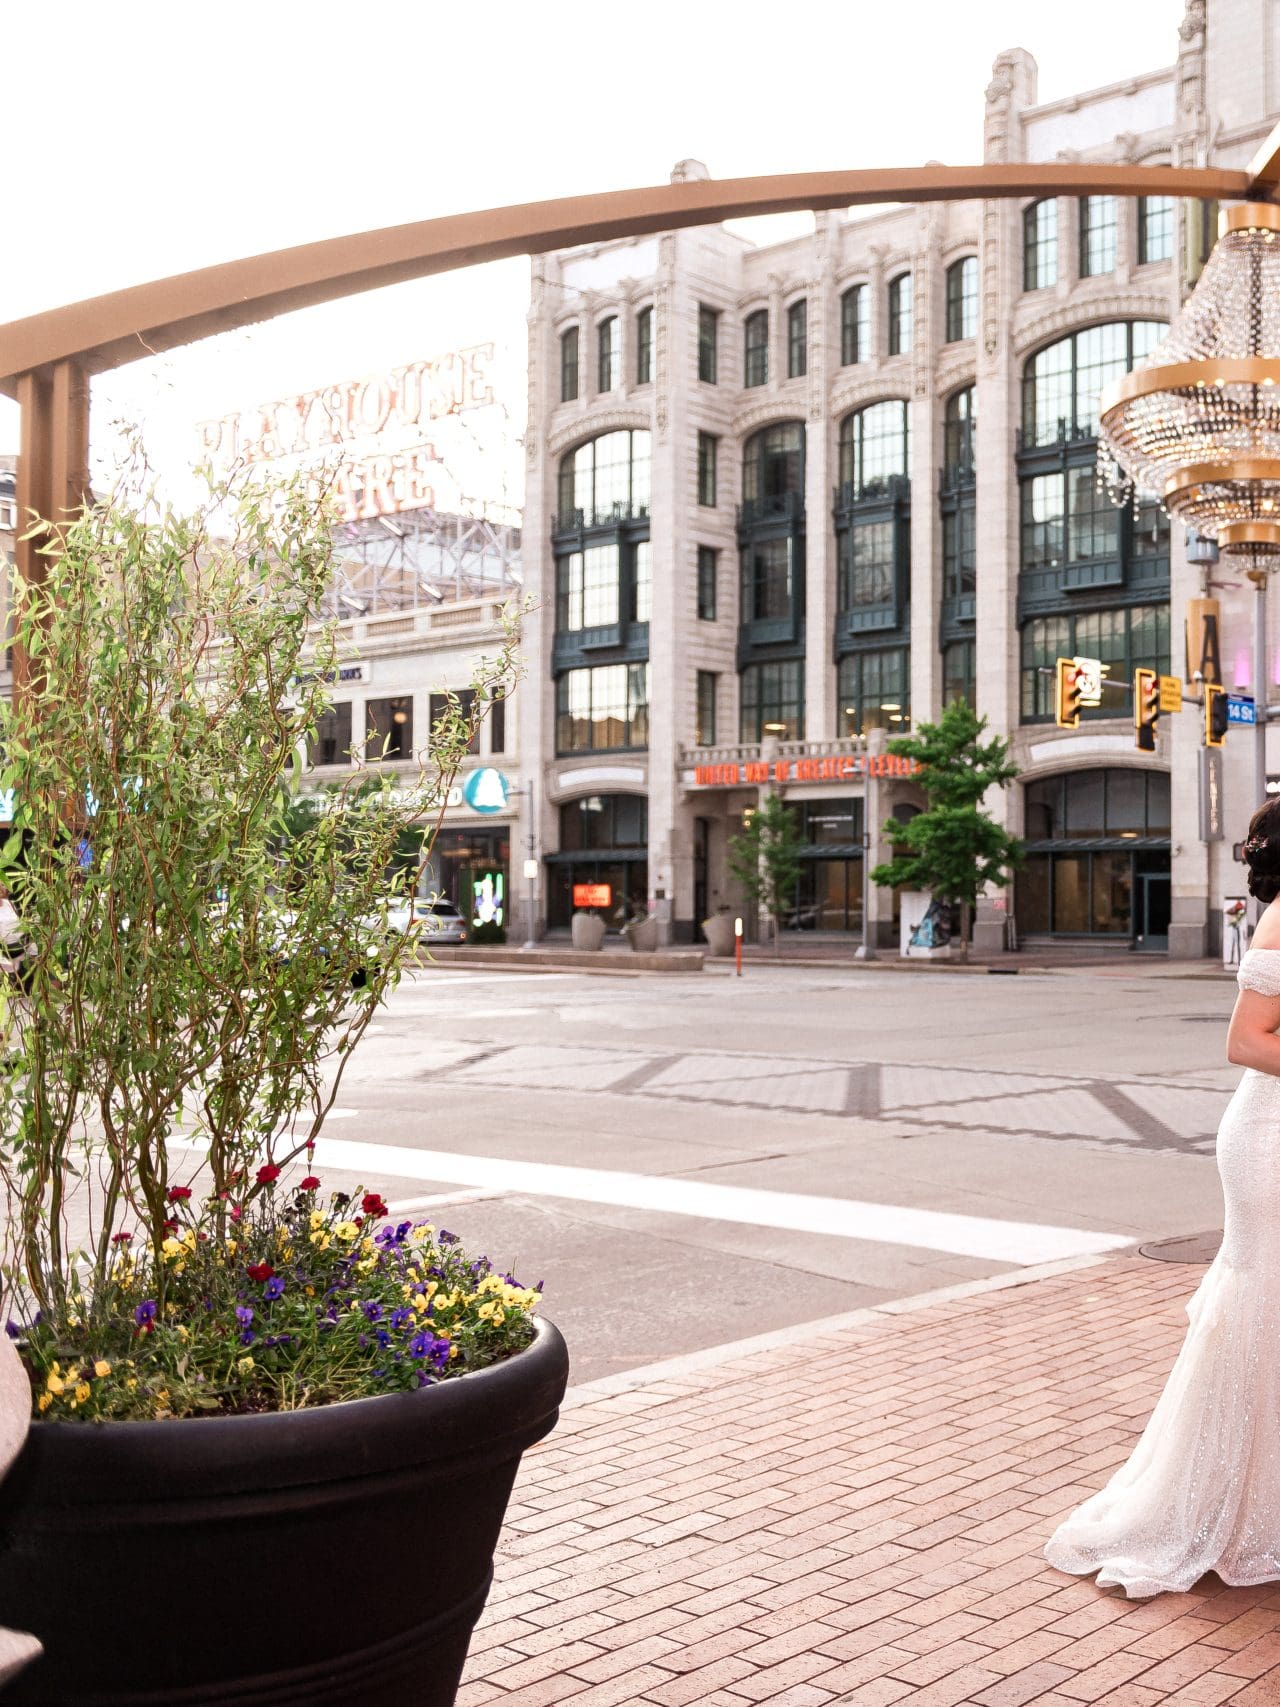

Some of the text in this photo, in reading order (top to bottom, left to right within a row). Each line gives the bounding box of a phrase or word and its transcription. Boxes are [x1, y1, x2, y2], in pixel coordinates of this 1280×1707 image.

[195, 343, 495, 467] PLAYHOUSE
[1228, 703, 1254, 721] 14 St
[695, 763, 739, 785] UNITED
[745, 761, 769, 784] WAY
[775, 759, 790, 783] OF
